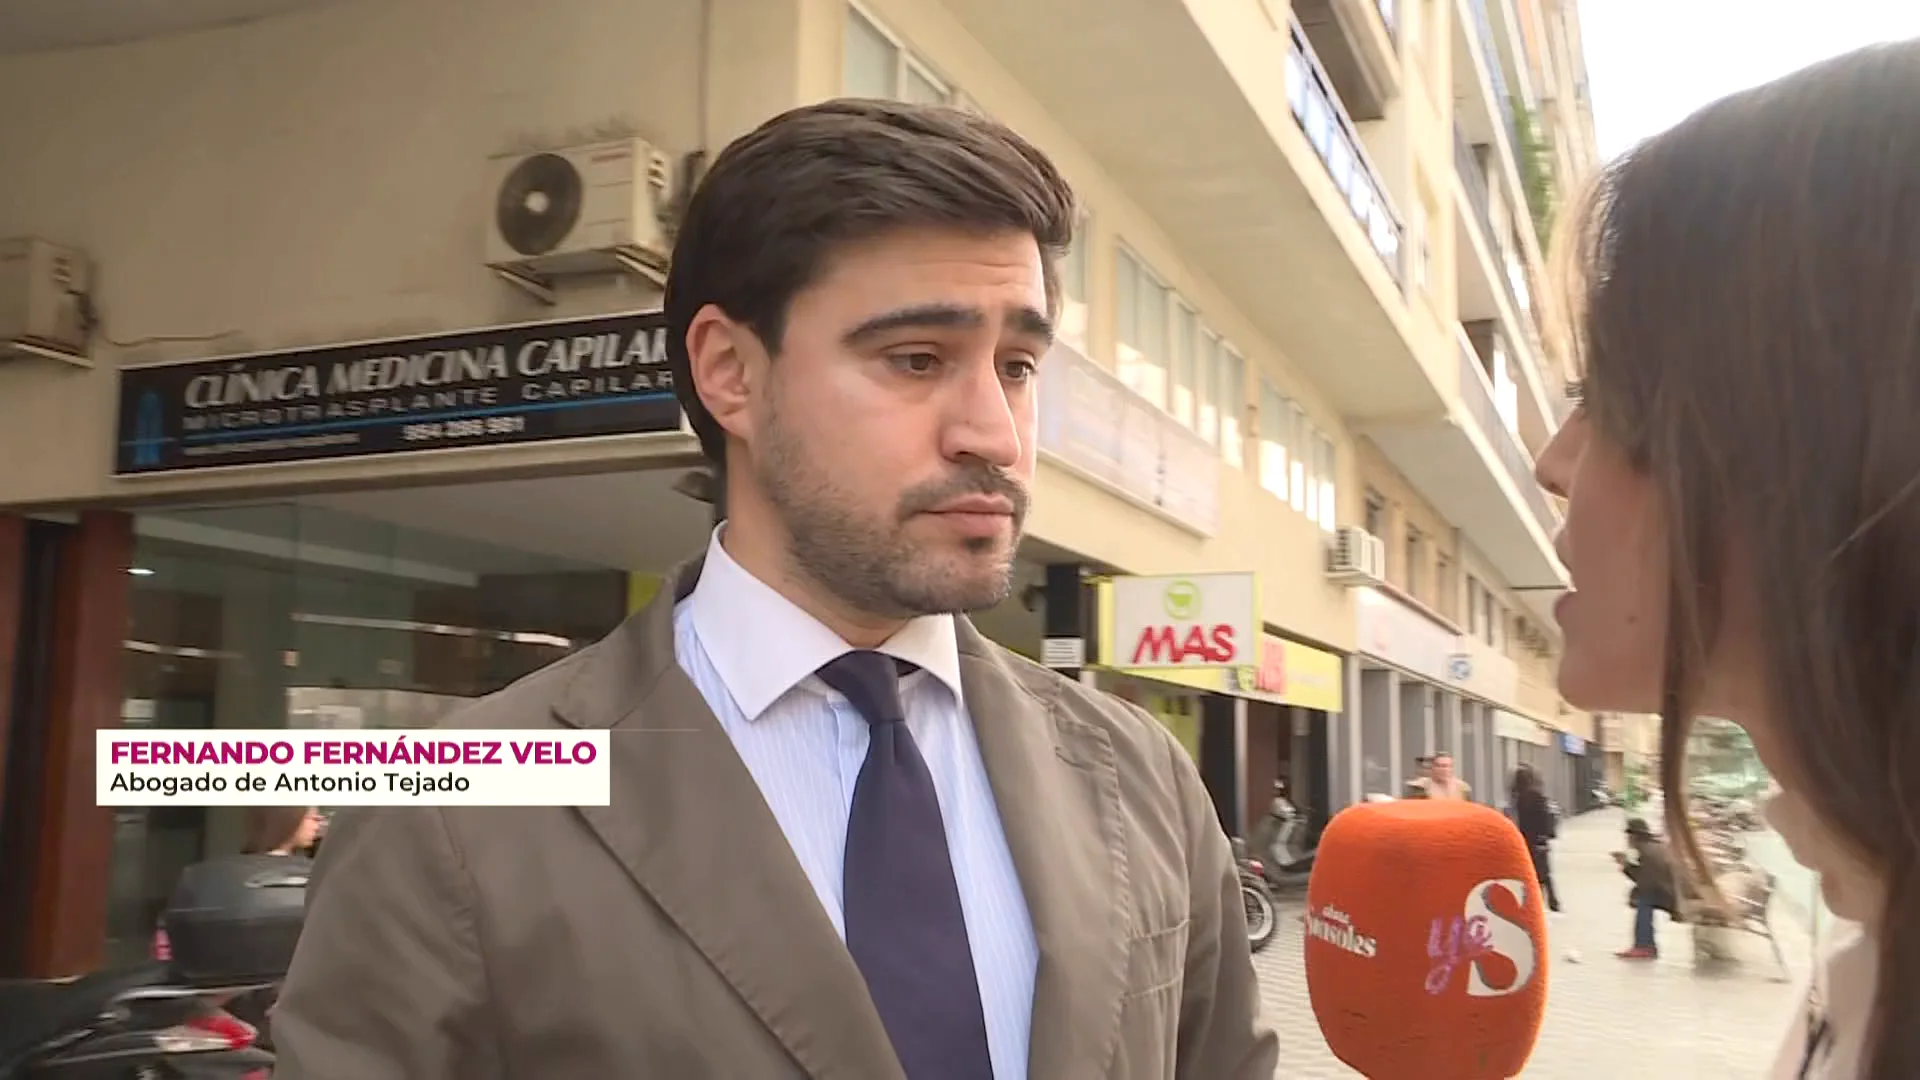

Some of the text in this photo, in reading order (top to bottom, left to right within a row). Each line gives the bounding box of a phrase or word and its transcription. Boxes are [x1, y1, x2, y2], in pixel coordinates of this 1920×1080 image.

[183, 370, 673, 430] MICROTRASPLANTE CAPILAR
[184, 363, 320, 409] CLÍNICA
[327, 345, 508, 395] MEDICINA
[1132, 624, 1236, 664] MAS
